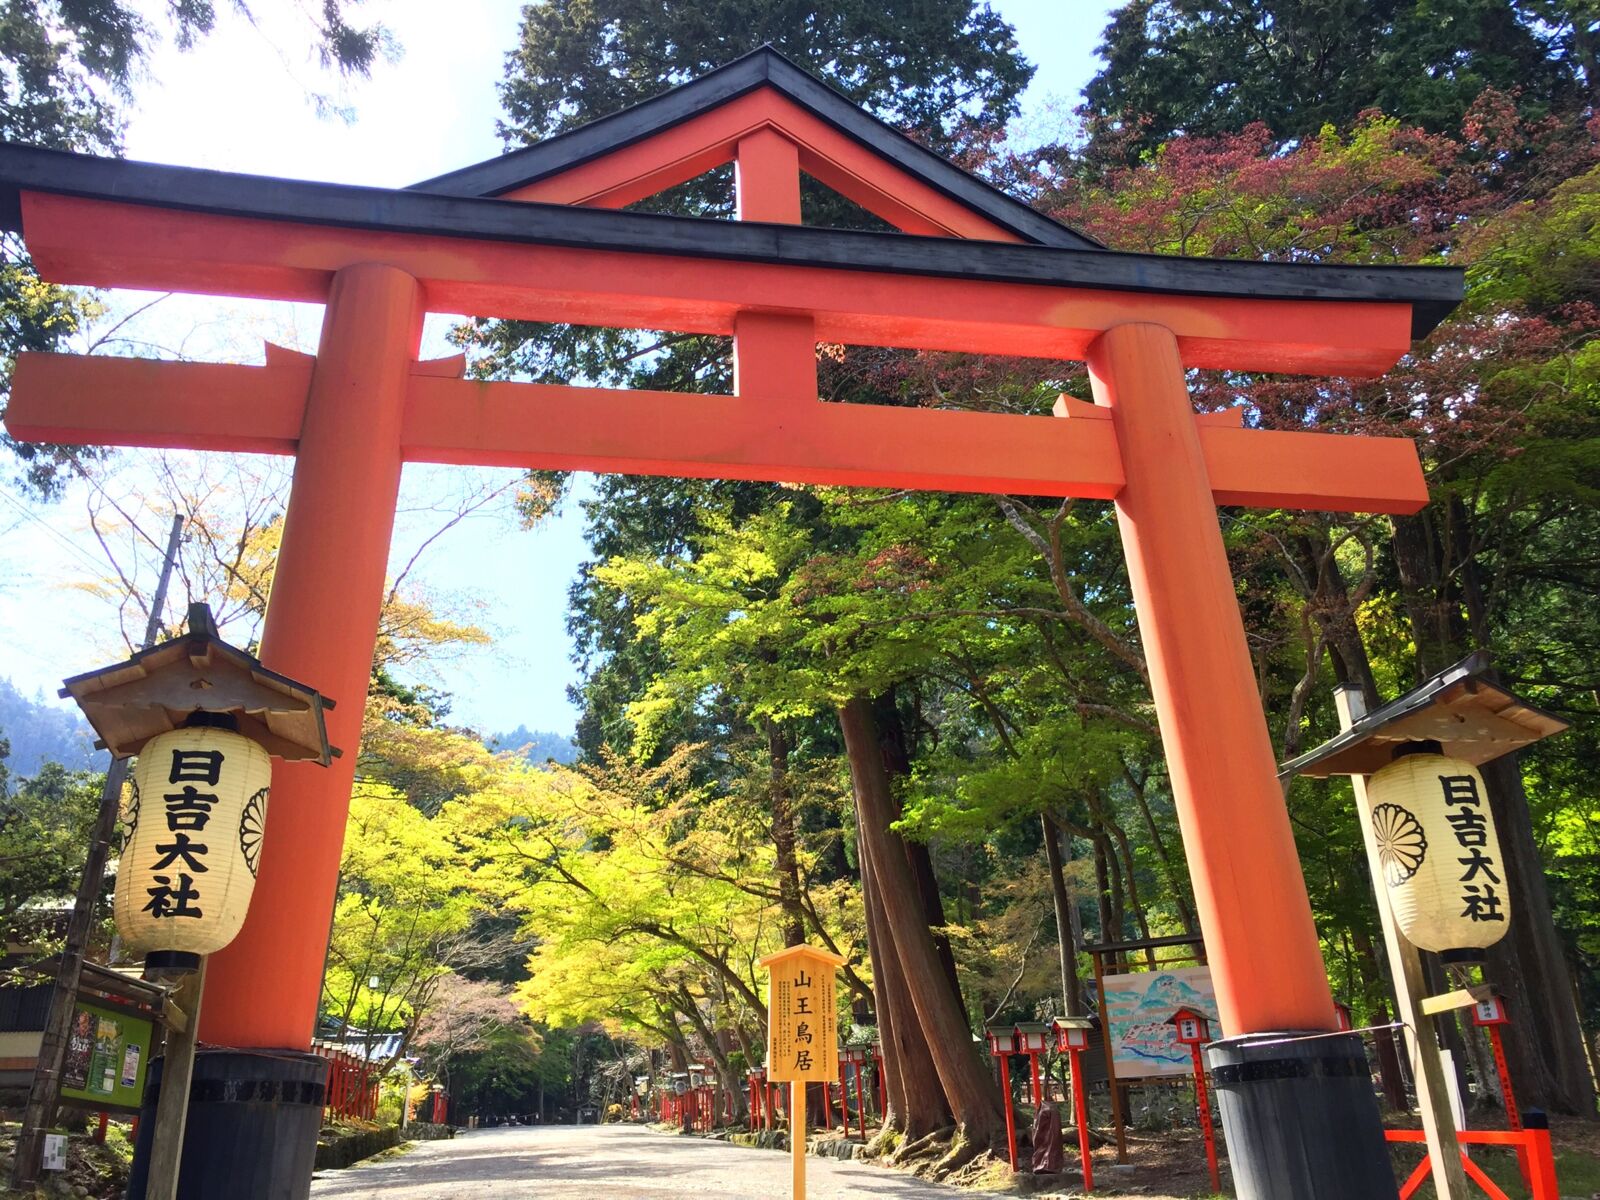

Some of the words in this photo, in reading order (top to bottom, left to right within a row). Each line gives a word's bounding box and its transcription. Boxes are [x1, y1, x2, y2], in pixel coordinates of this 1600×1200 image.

[141, 749, 225, 919] 日吉大社
[1438, 774, 1504, 922] 日吉大社
[793, 970, 813, 1071] 山王鳥居
